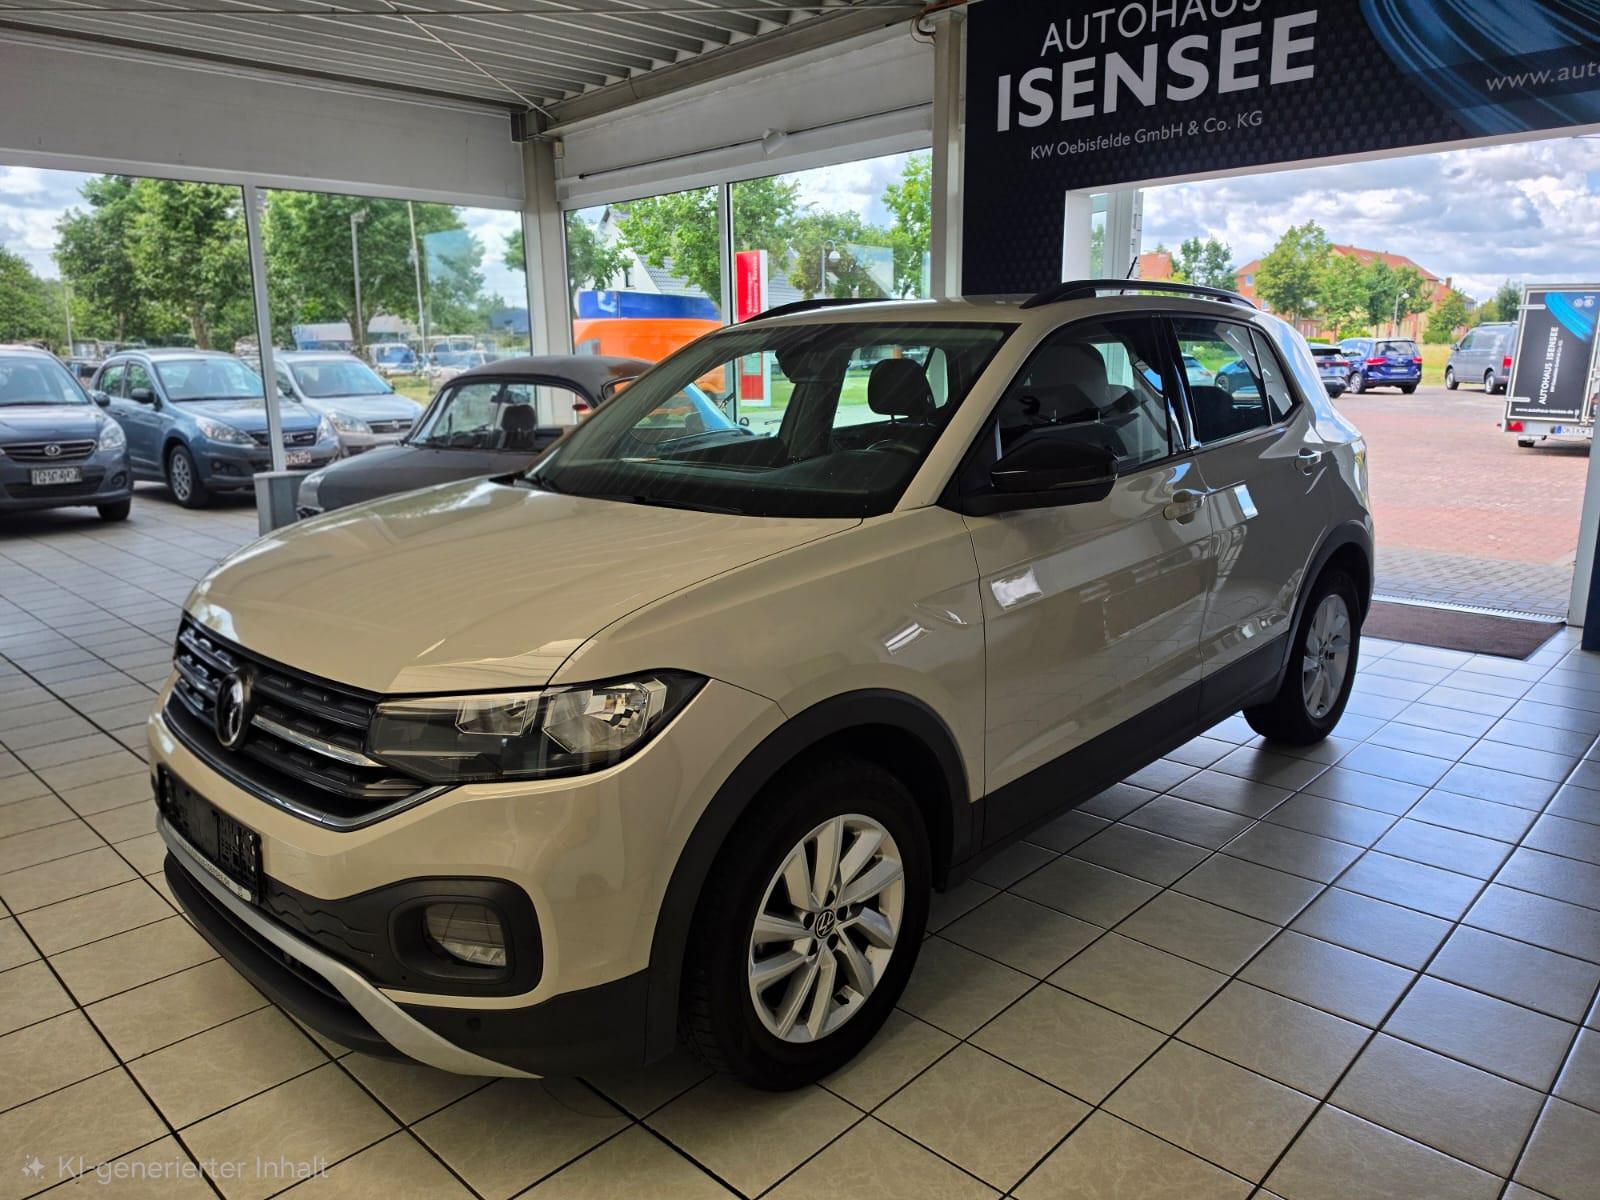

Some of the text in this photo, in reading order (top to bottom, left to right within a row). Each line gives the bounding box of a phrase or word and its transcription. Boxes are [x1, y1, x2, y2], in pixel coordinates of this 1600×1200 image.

[997, 10, 1318, 132] ISENSEE
[1486, 61, 1600, 91] www.aut
[1031, 110, 1263, 160] KW Oebisfelde GmbH & Co. KG
[1545, 326, 1559, 361] ISENSEE
[1538, 362, 1553, 405] AUTOHAUS
